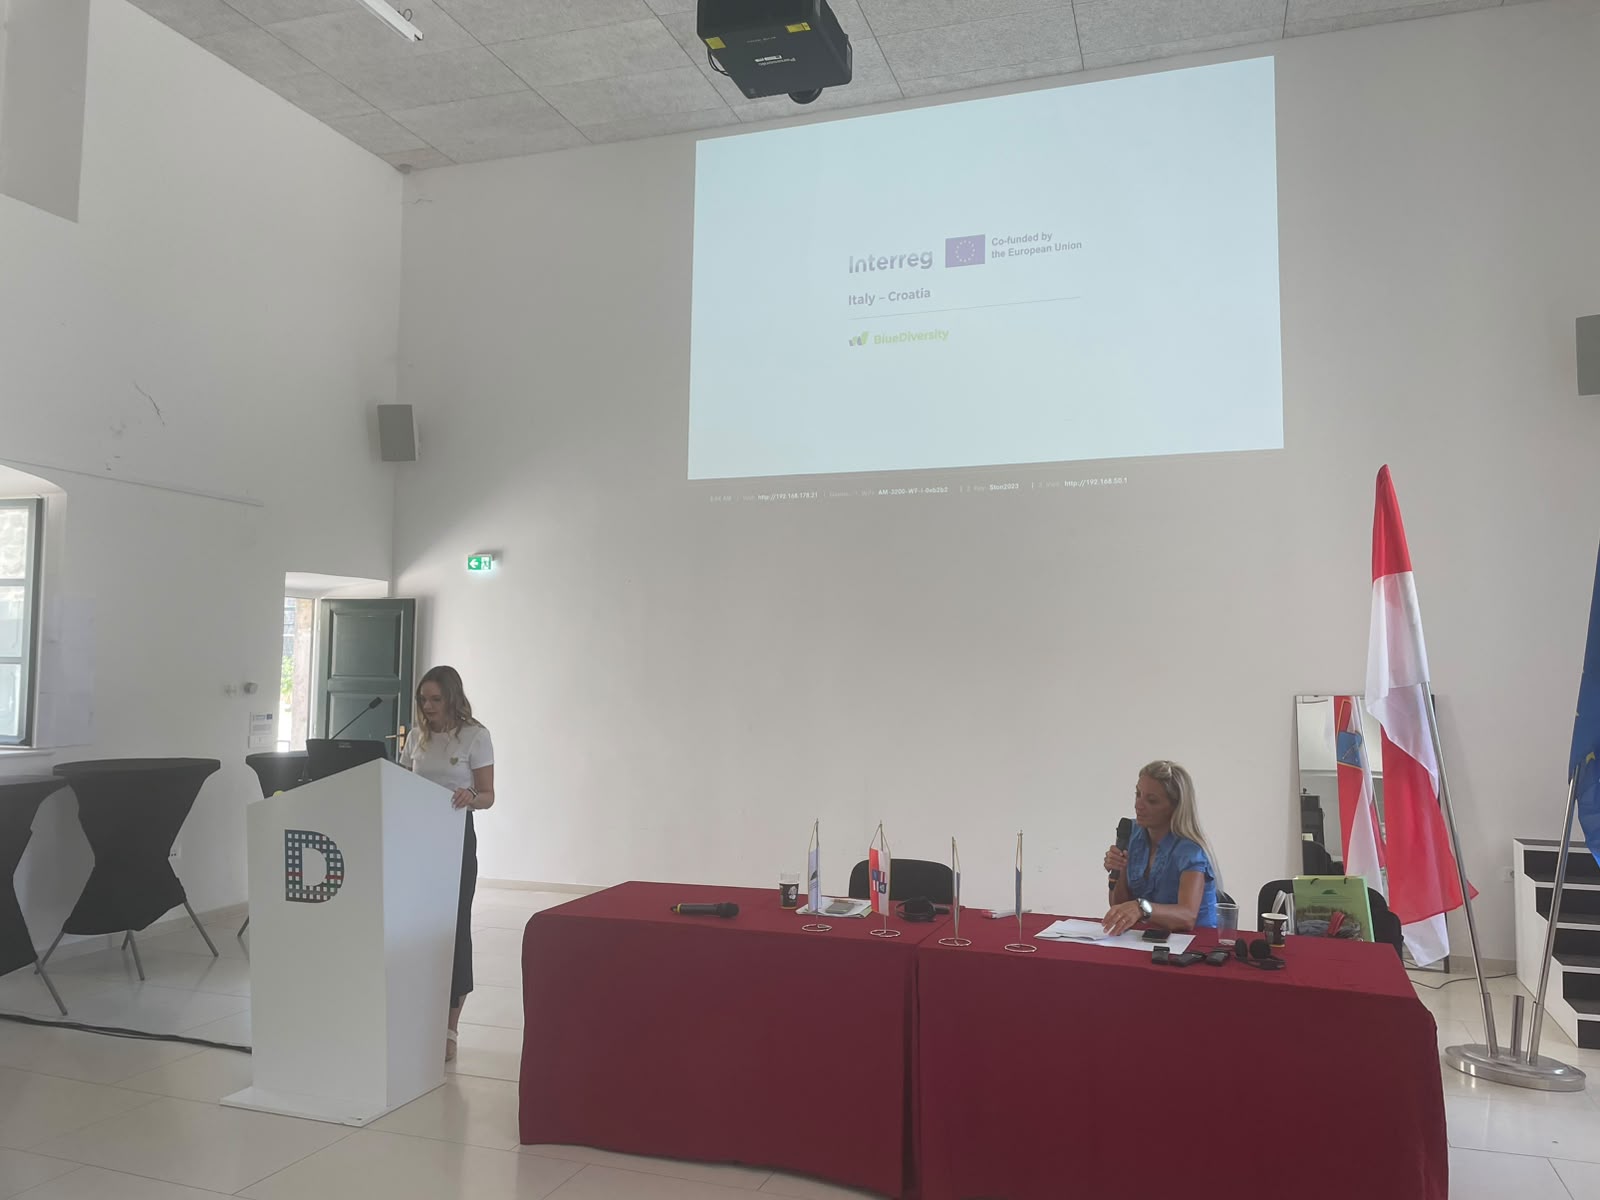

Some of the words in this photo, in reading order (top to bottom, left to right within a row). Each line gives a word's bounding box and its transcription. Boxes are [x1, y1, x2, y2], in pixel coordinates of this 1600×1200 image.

[991, 232, 1039, 246] Co-funded
[1041, 231, 1053, 242] by
[991, 249, 1006, 259] the
[1008, 245, 1052, 257] European
[1054, 241, 1082, 252] Union
[848, 251, 933, 274] Interreg
[848, 292, 876, 306] Italy
[888, 287, 931, 302] Croatia
[873, 328, 949, 345] BlueDiversity
